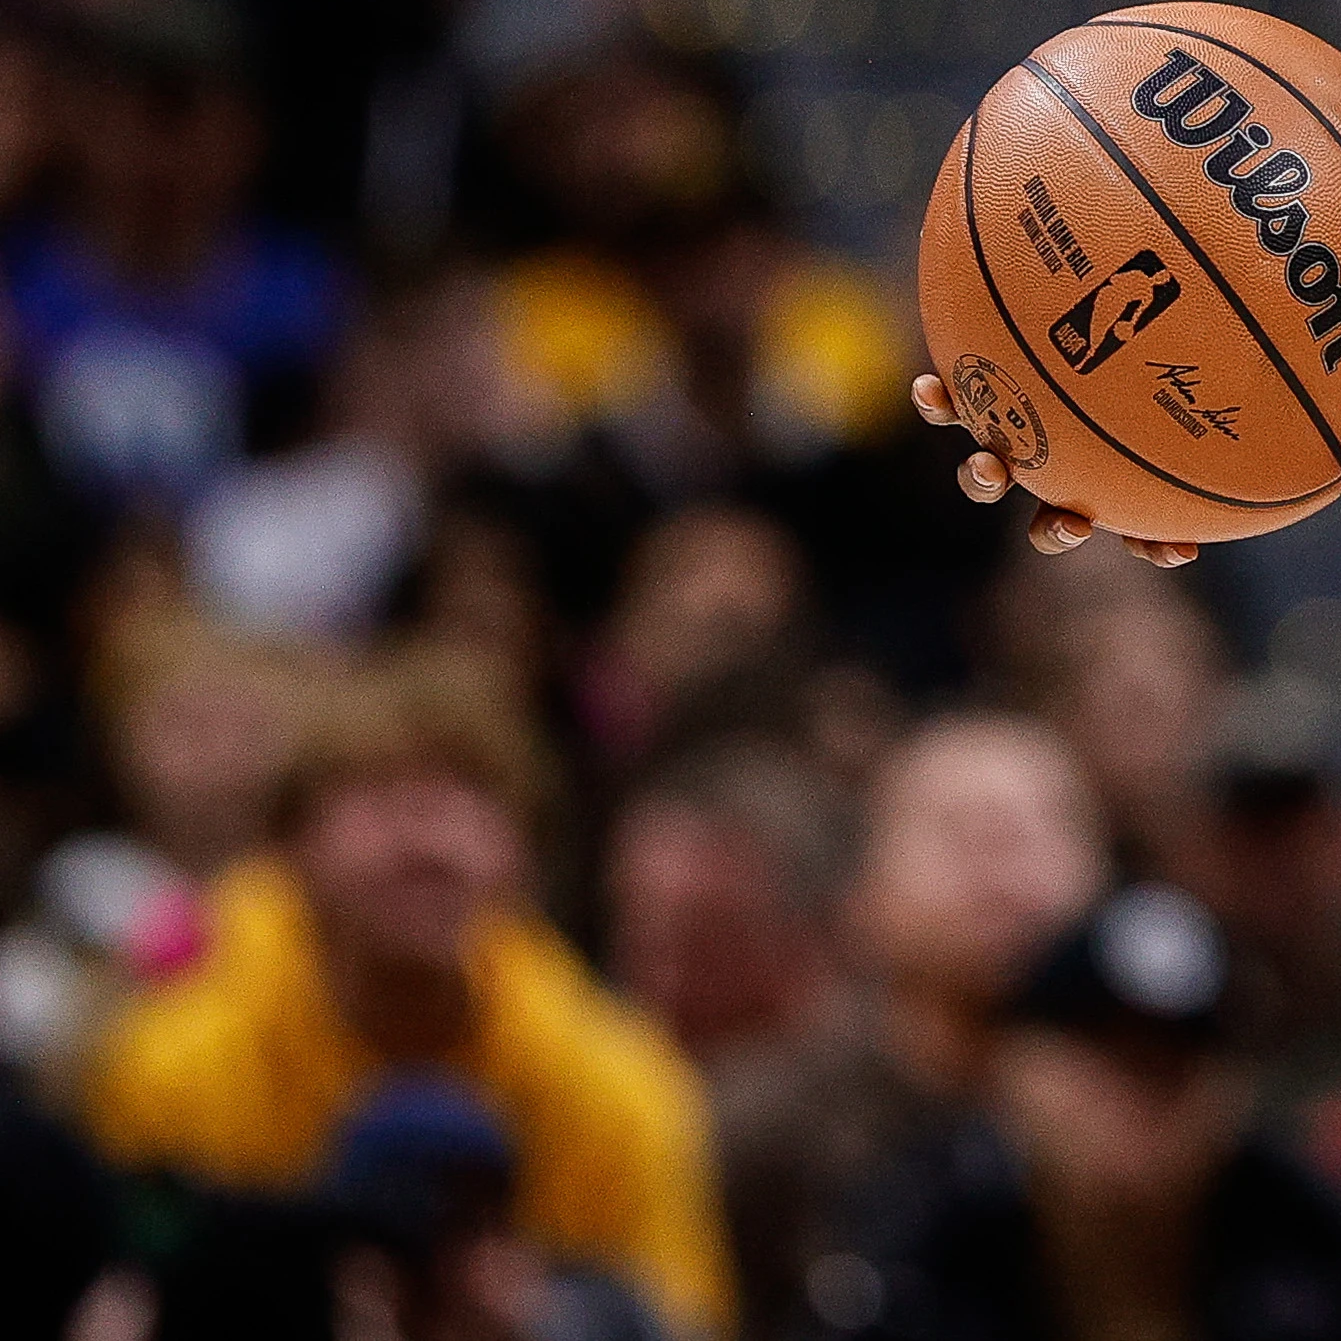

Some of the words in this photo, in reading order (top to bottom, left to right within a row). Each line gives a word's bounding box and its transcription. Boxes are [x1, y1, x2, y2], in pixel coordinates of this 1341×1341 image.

[1023, 174, 1059, 225] OFFICIAL
[1047, 218, 1078, 255] GAME
[1064, 246, 1094, 281] BALL
[1035, 237, 1063, 275] LEATHER
[1054, 322, 1087, 356] NBA
[1153, 388, 1208, 440] COMMISSIONER
